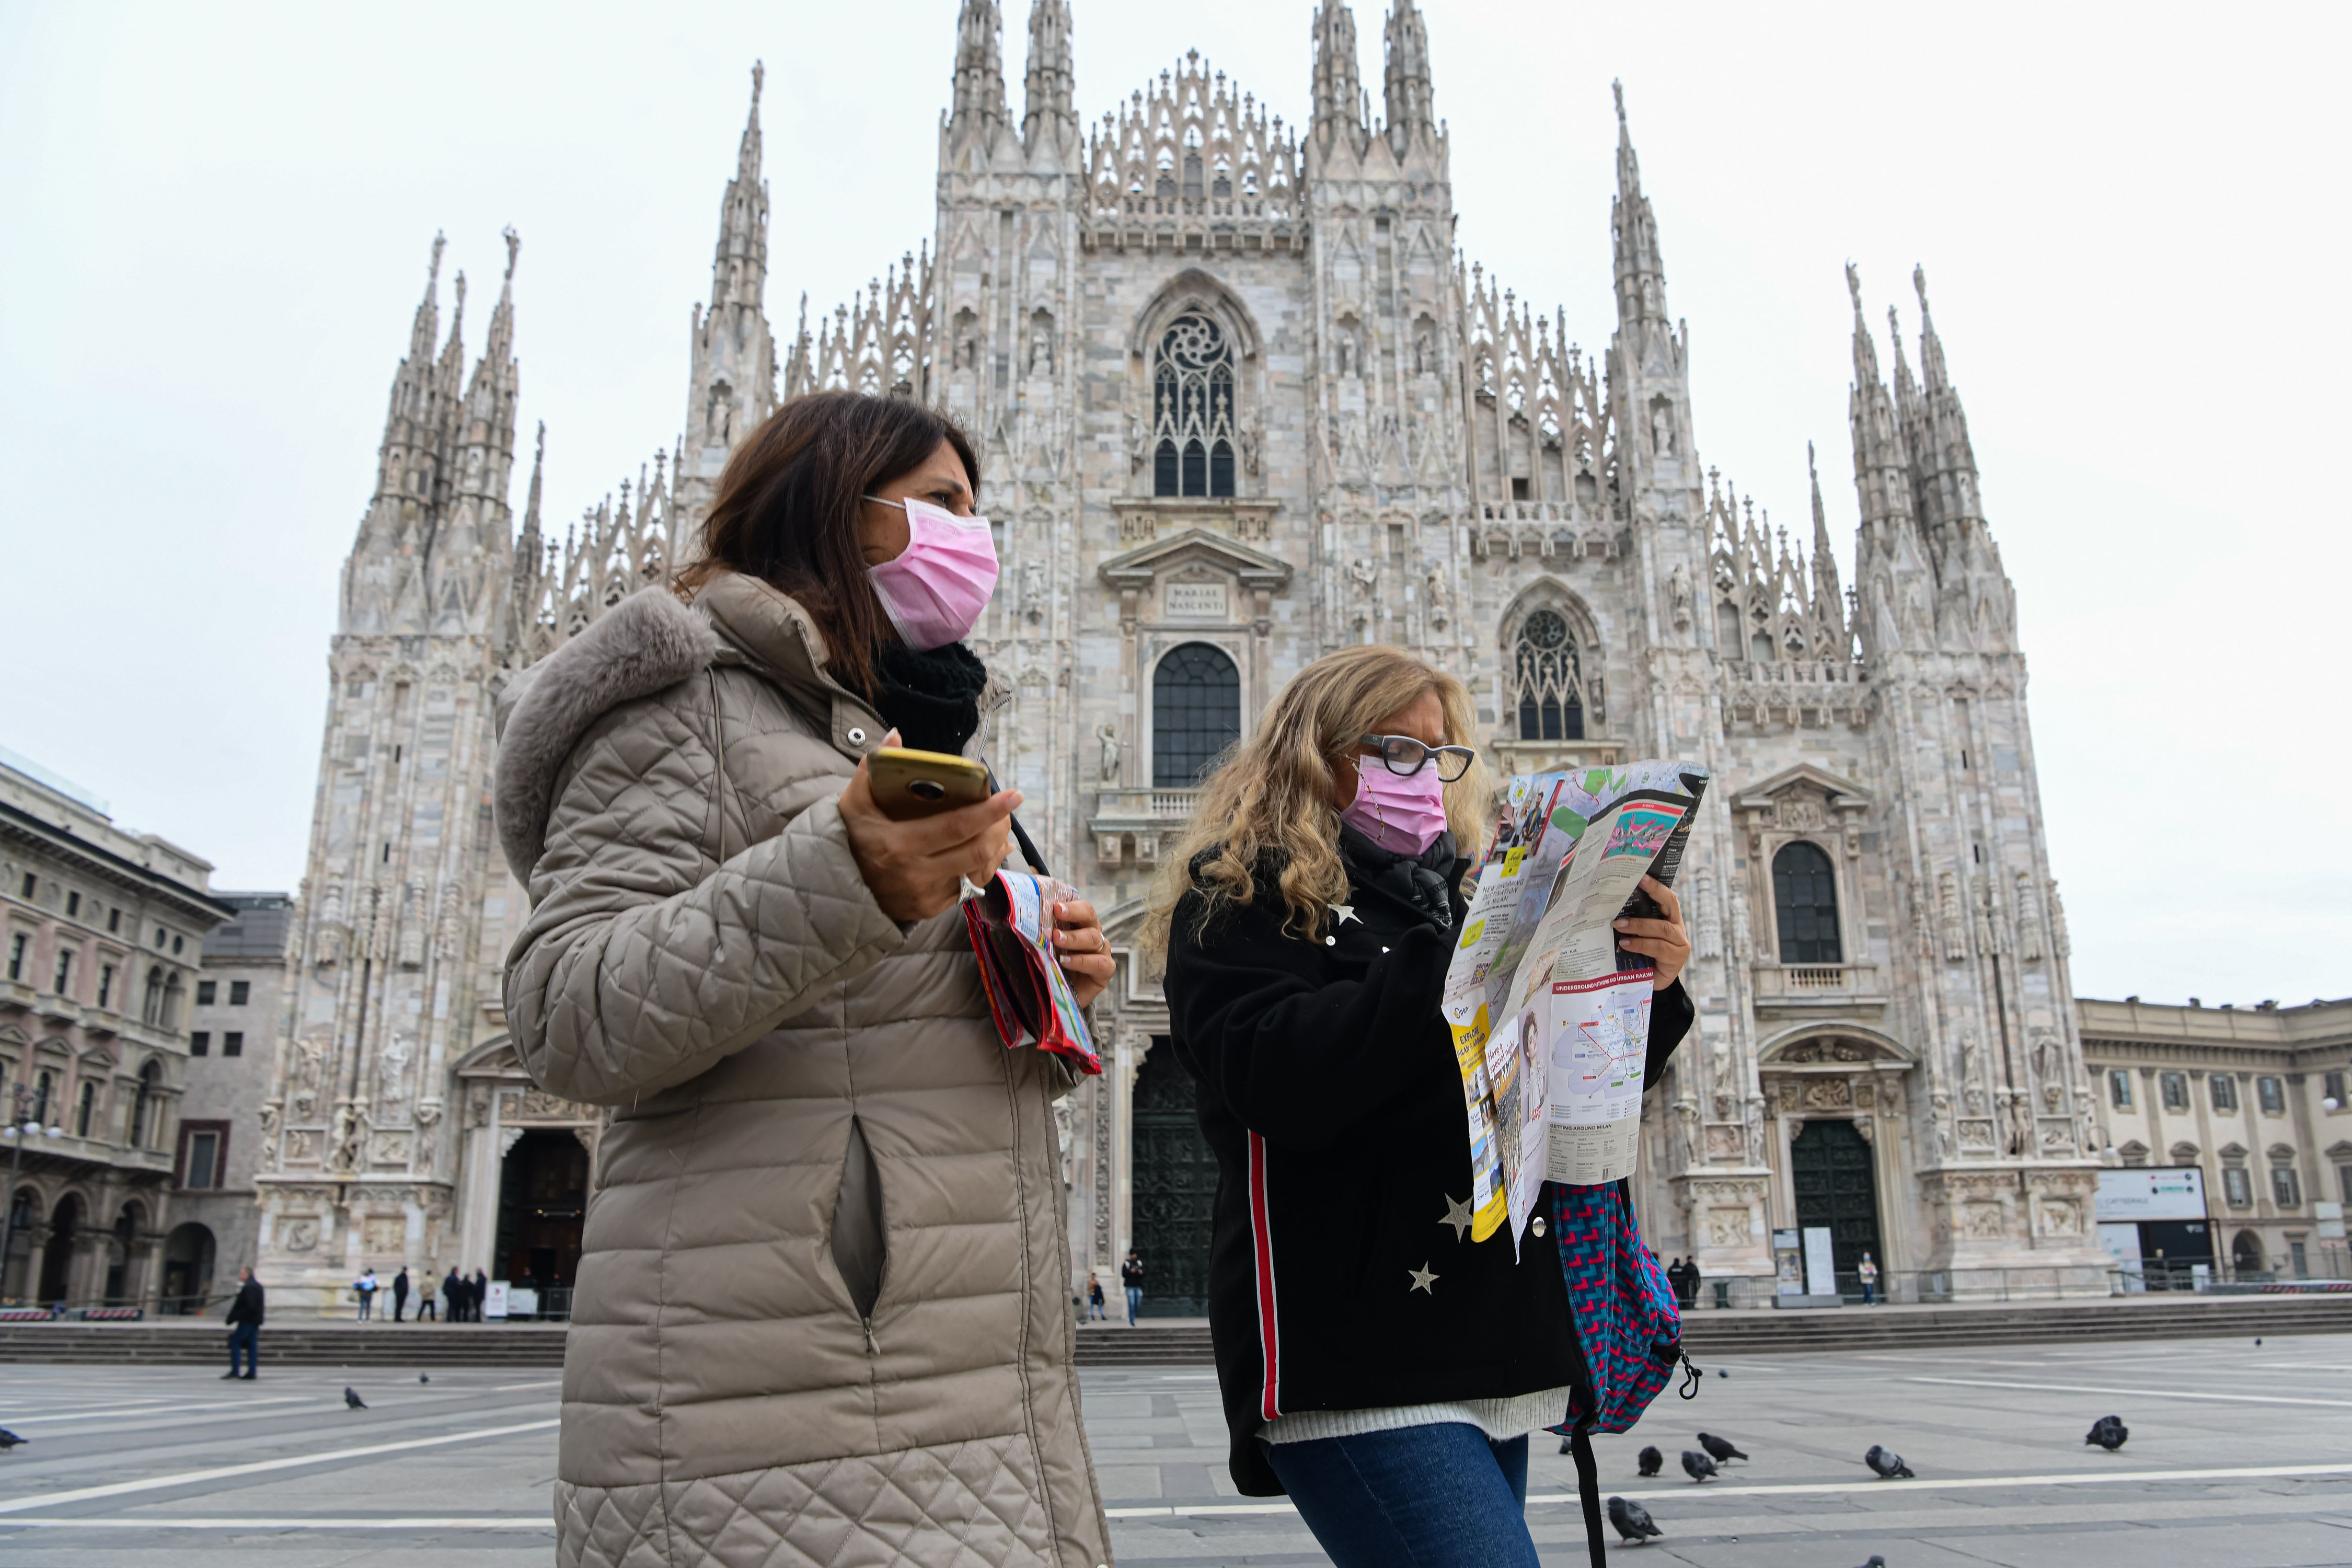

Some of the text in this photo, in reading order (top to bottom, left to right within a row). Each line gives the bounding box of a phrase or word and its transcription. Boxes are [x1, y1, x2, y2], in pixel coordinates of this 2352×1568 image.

[1482, 886, 1518, 901] DESTINATION
[1483, 879, 1524, 893] NEW SHOPPING
[1491, 895, 1508, 904] MILAN
[1459, 1025, 1480, 1044] EXPLORE
[1457, 1044, 1470, 1057] MILAN
[1473, 1032, 1485, 1048] AROUND
[1488, 1045, 1499, 1063] Have
[1490, 1049, 1505, 1075] special
[1493, 1057, 1516, 1091] in Milan
